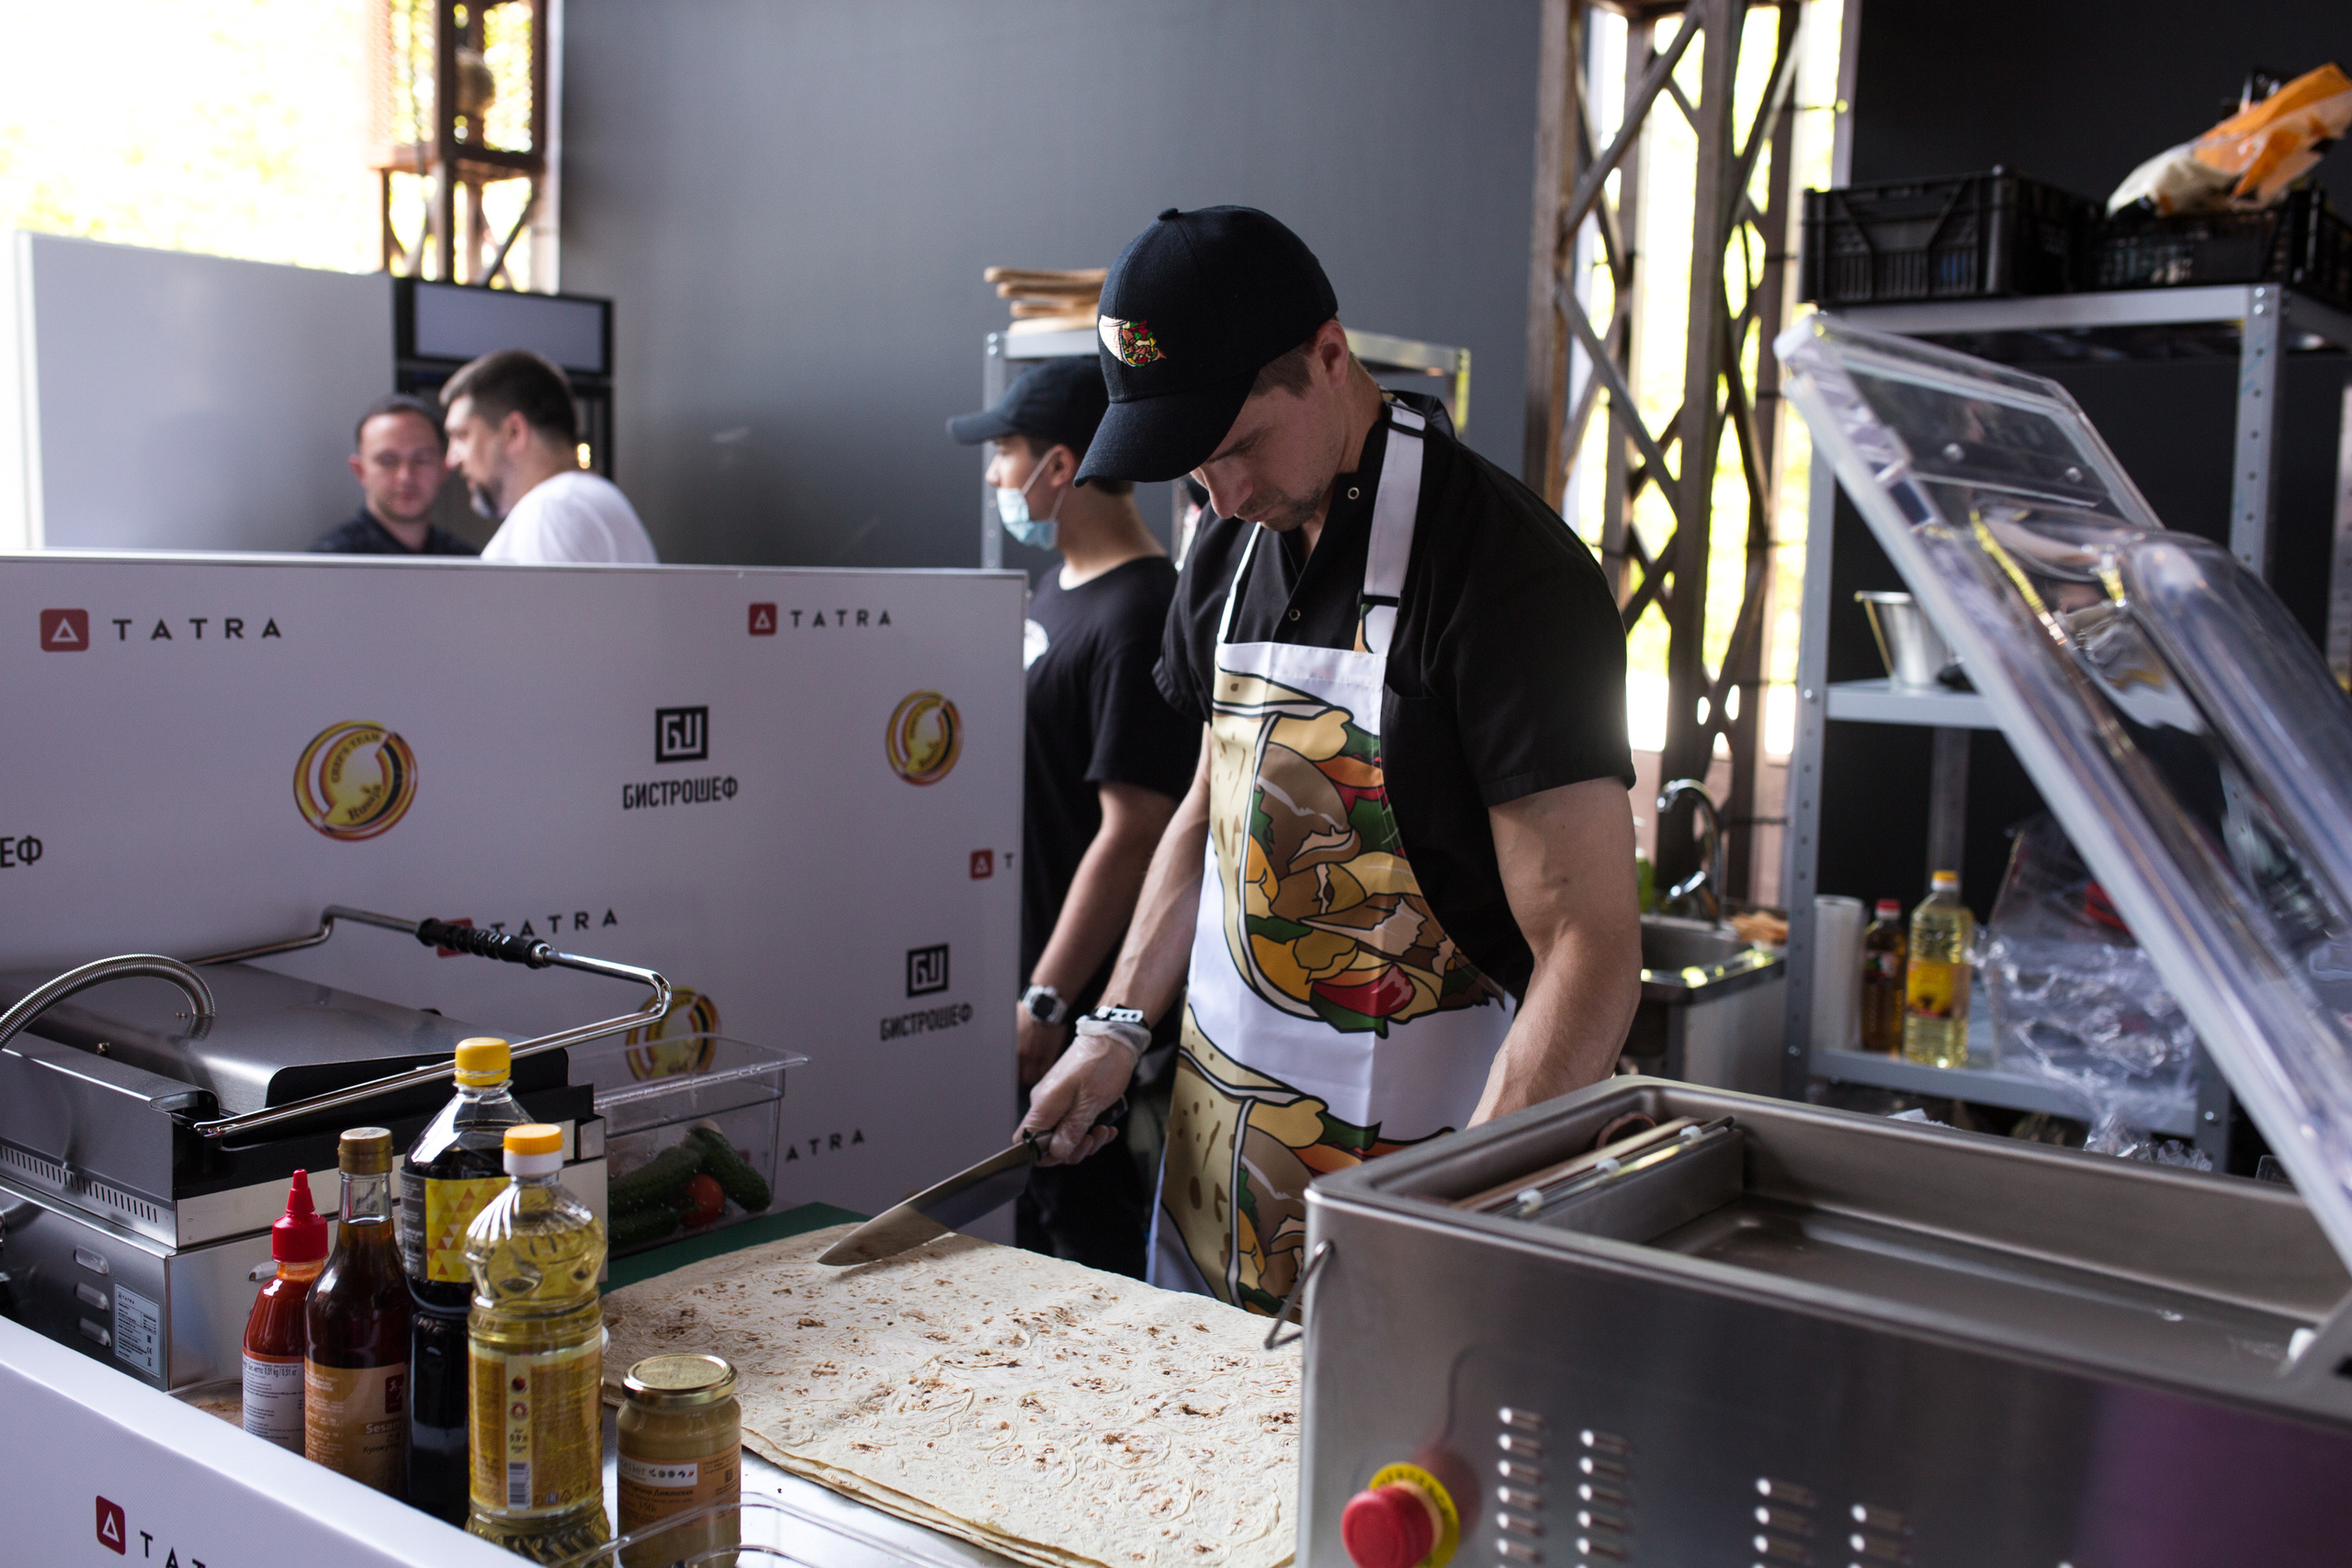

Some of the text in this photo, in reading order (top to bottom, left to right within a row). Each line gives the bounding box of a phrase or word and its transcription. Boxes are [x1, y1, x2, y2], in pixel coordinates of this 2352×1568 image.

[112, 618, 282, 641] TATRA
[790, 608, 892, 629] TATRA
[622, 775, 738, 812] БИСТРОШЕФ
[879, 1001, 974, 1042] БИСТРОШЕФ
